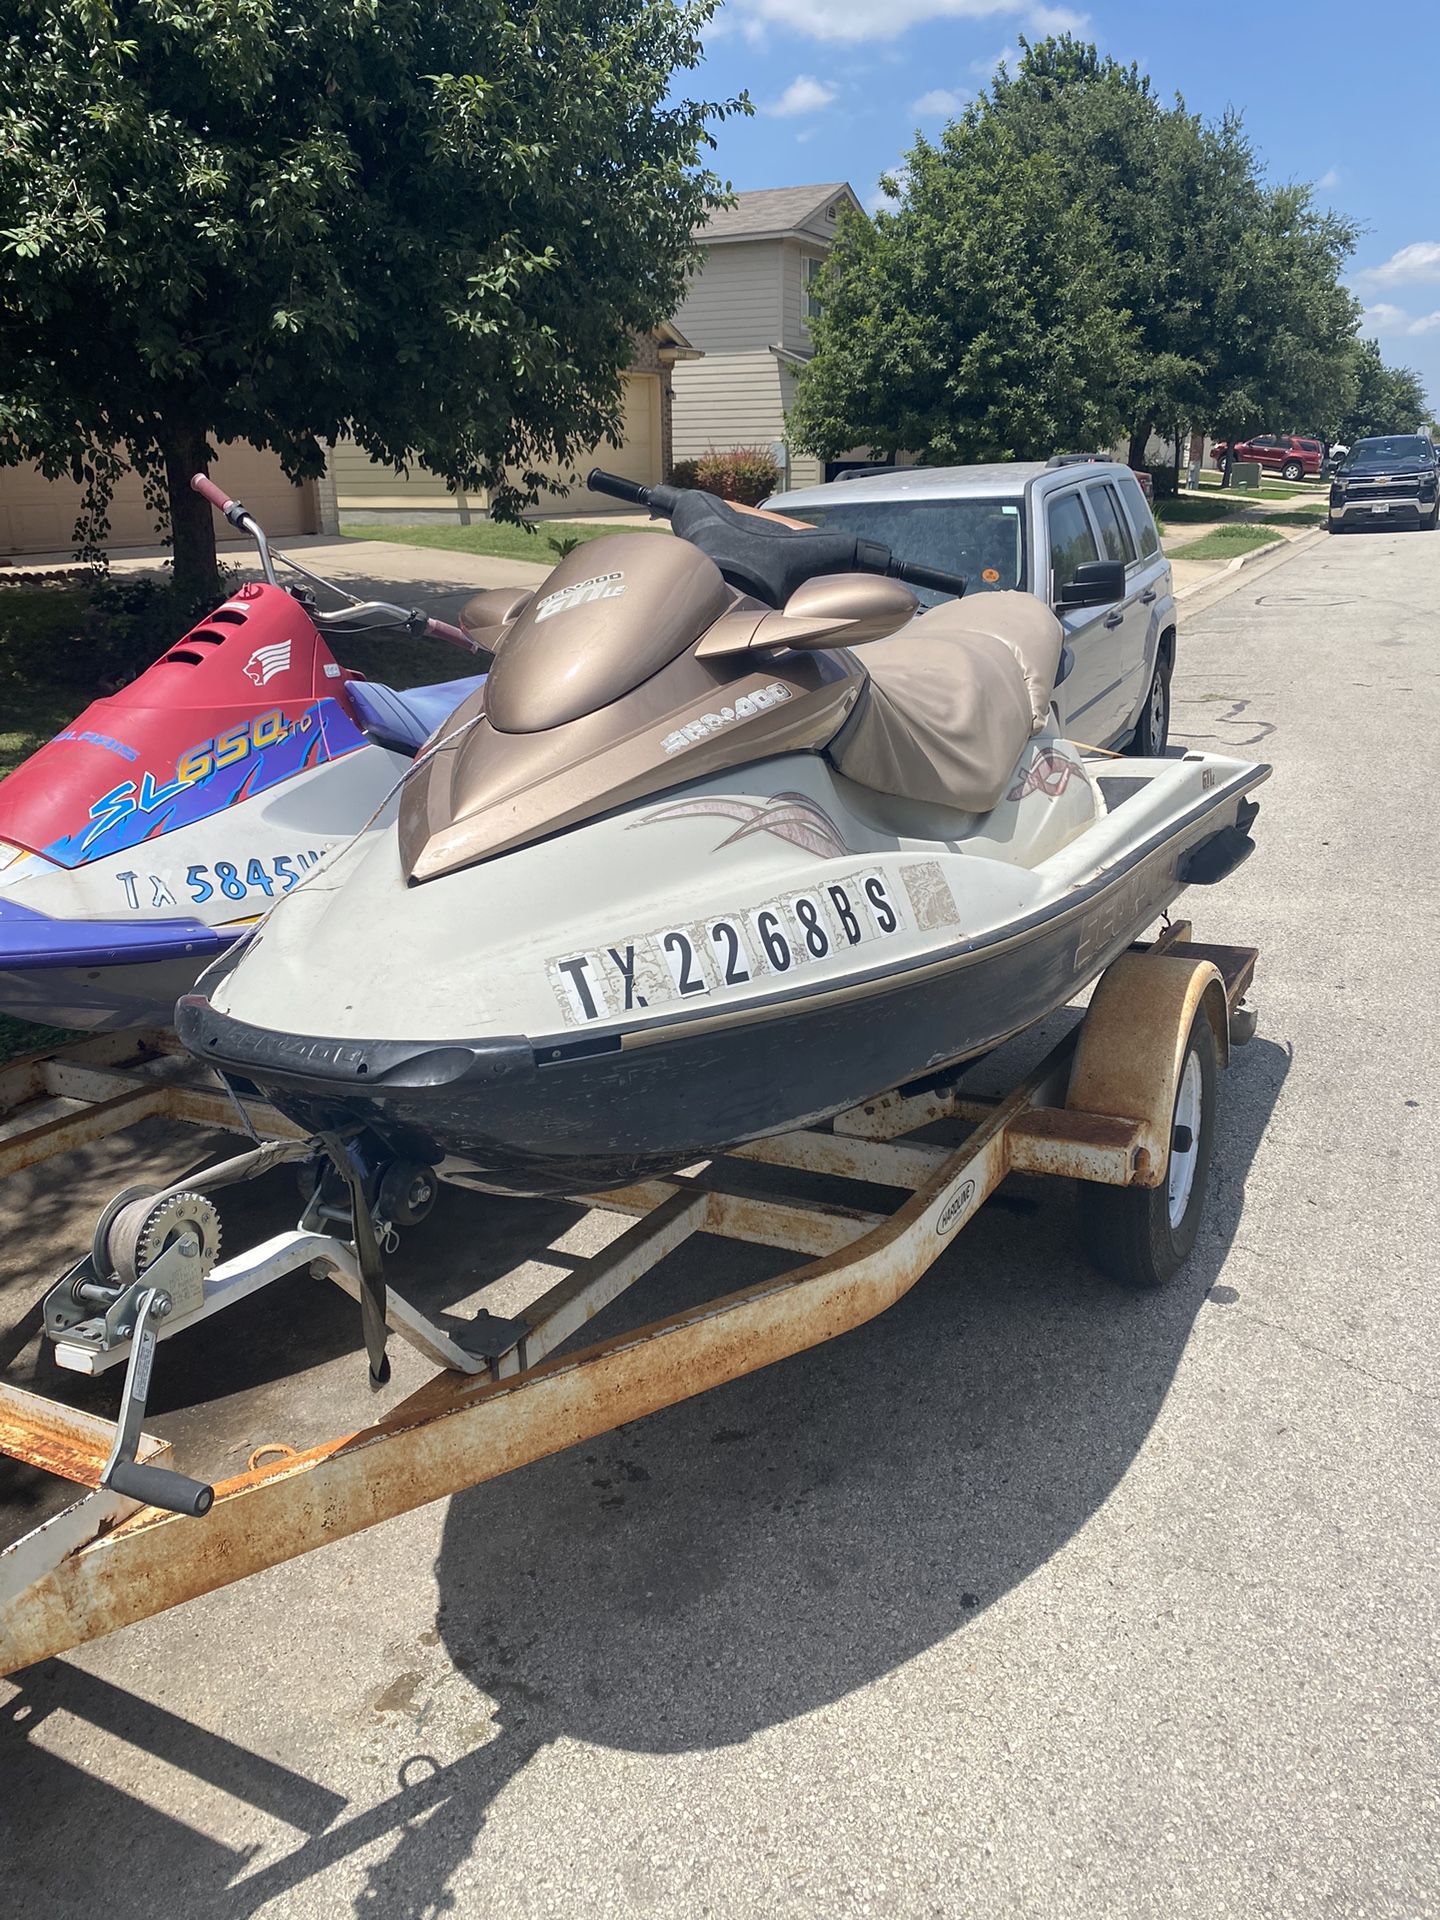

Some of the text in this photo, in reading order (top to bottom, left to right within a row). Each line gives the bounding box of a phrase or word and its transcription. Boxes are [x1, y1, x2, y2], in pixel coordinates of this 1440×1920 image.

[81, 771, 196, 852] SL
[177, 709, 286, 786] 650
[117, 871, 177, 909] TX
[558, 877, 897, 1020] TX 2268BS
